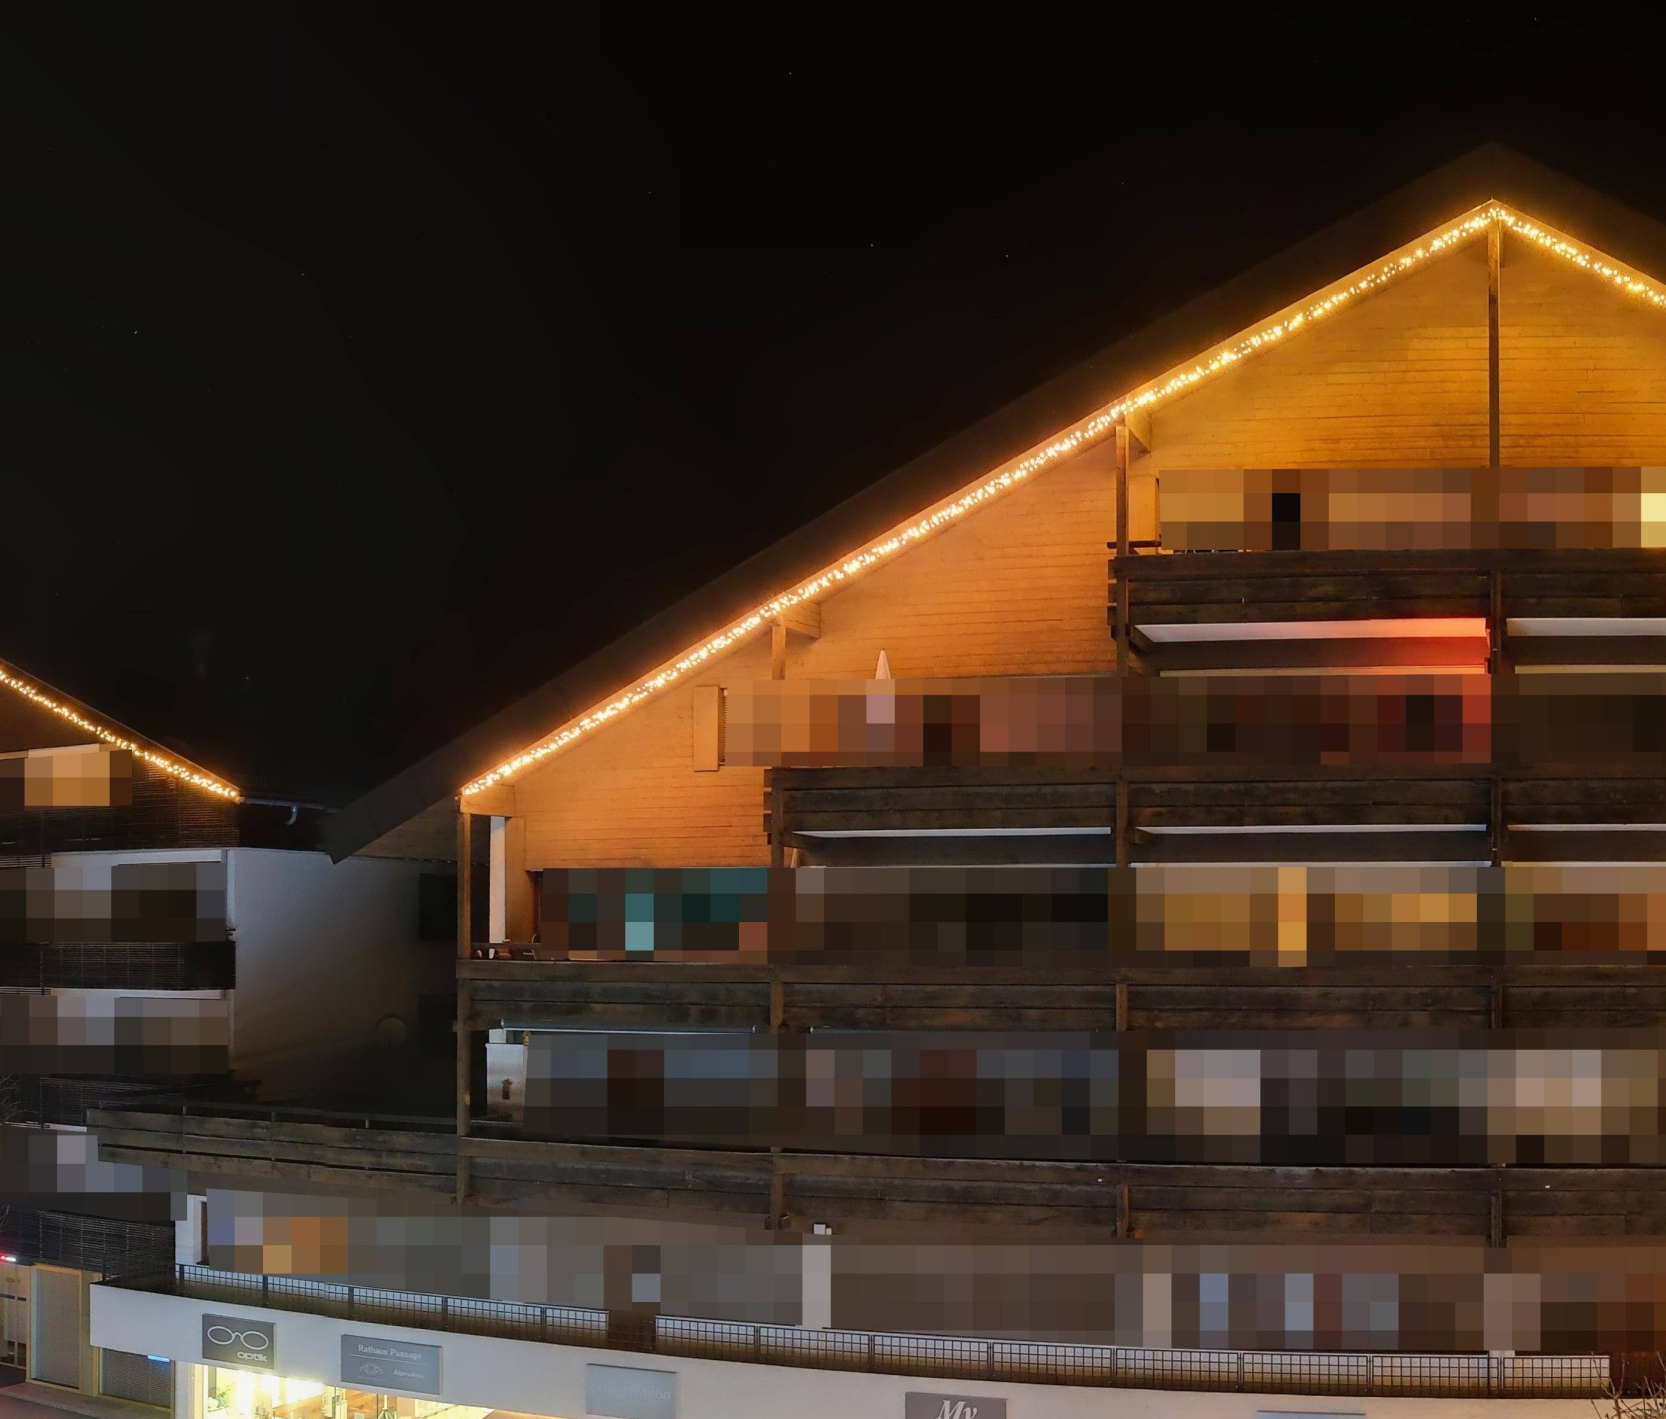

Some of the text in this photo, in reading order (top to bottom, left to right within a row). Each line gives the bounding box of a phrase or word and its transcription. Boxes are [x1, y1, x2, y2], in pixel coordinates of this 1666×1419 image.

[236, 1350, 268, 1363] optik
[358, 1343, 422, 1360] Rathaus Passage
